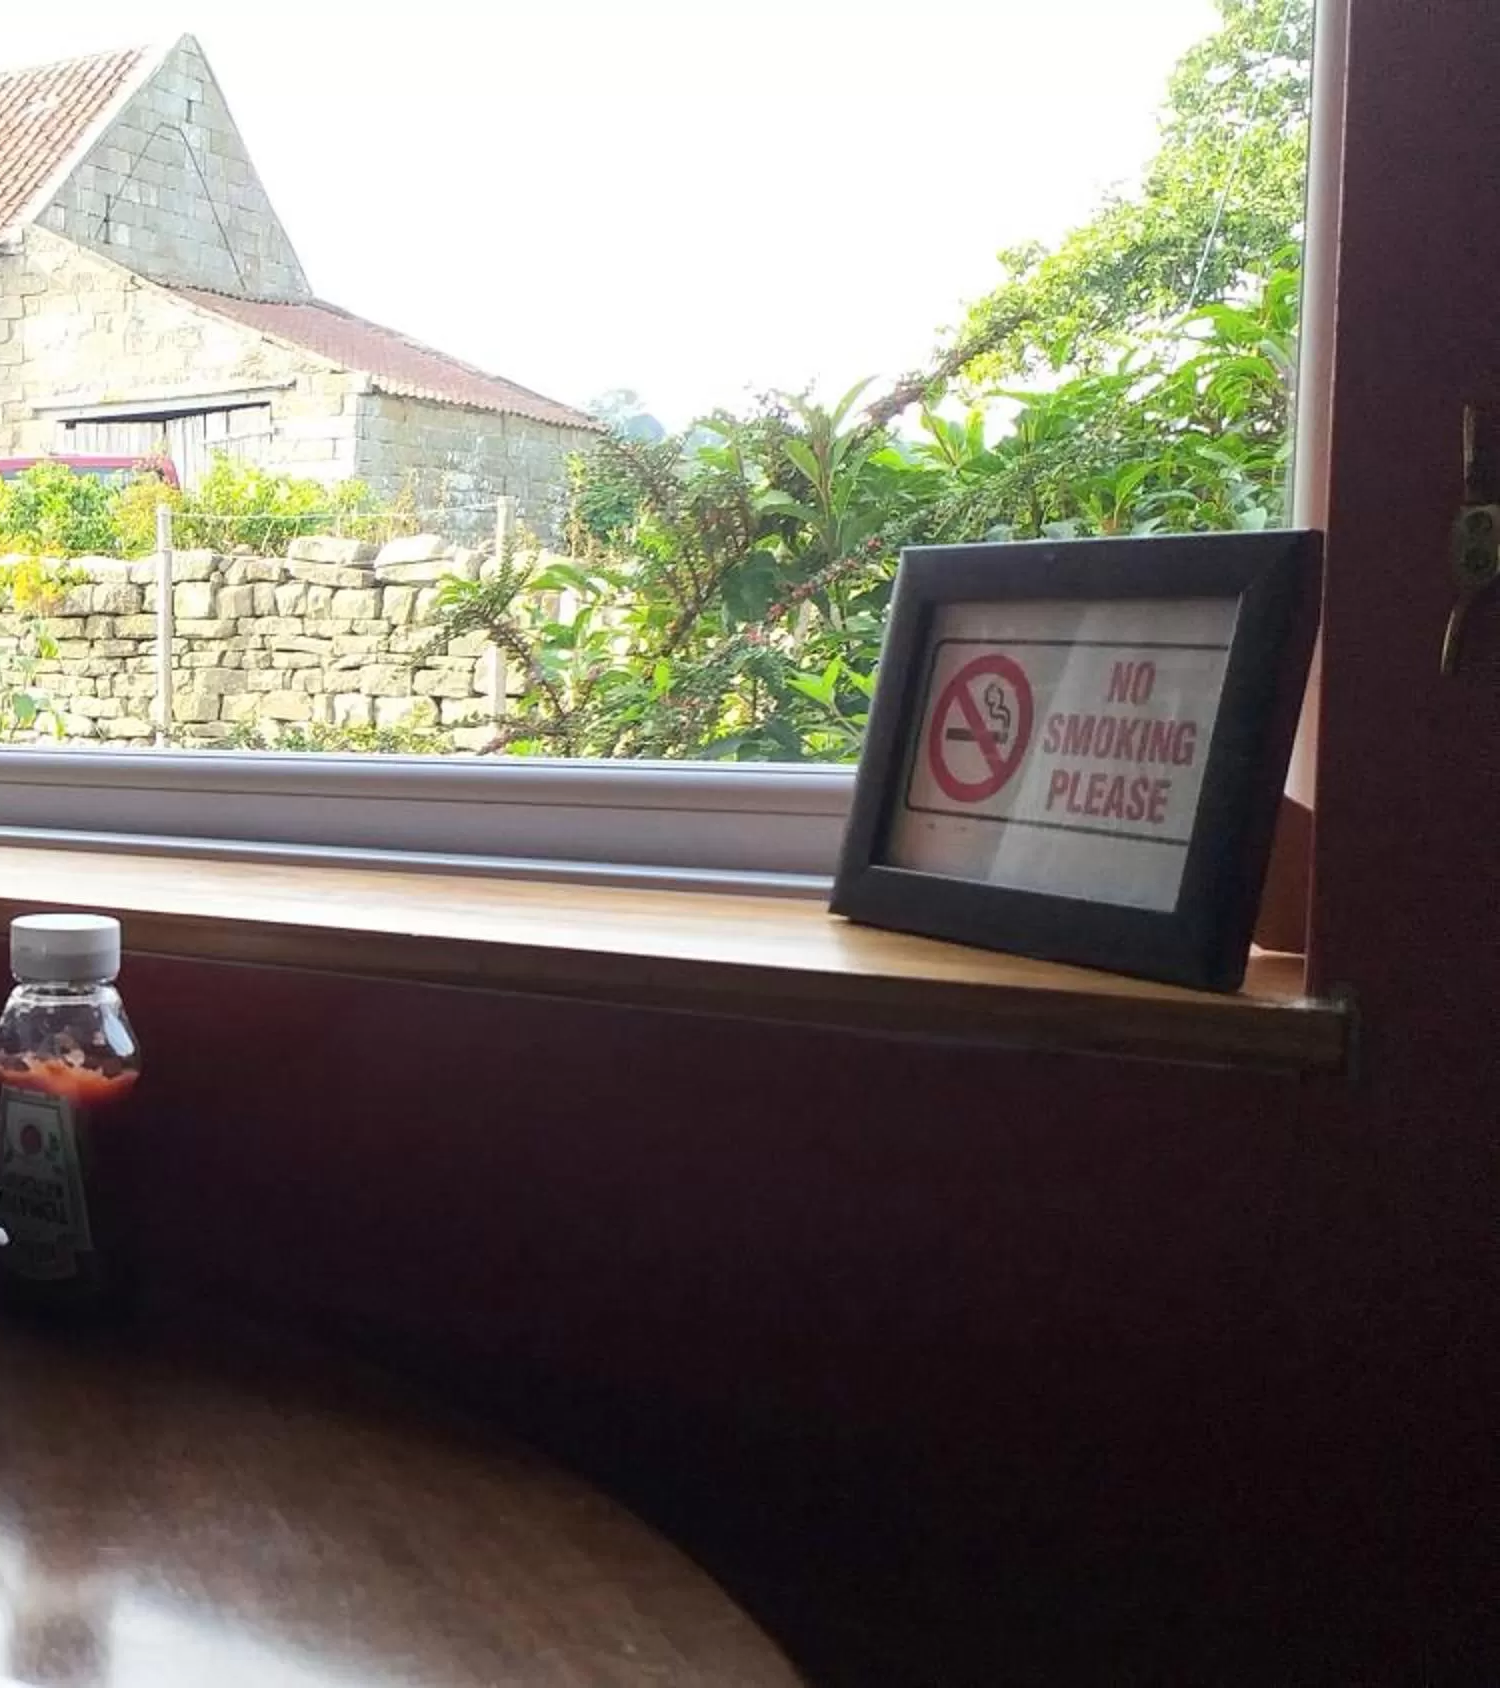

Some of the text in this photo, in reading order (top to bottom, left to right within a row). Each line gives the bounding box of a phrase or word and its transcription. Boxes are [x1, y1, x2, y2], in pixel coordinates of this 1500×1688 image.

[1107, 660, 1156, 706] NO
[1043, 713, 1197, 767] SMOKING
[1046, 770, 1173, 824] PLEASE
